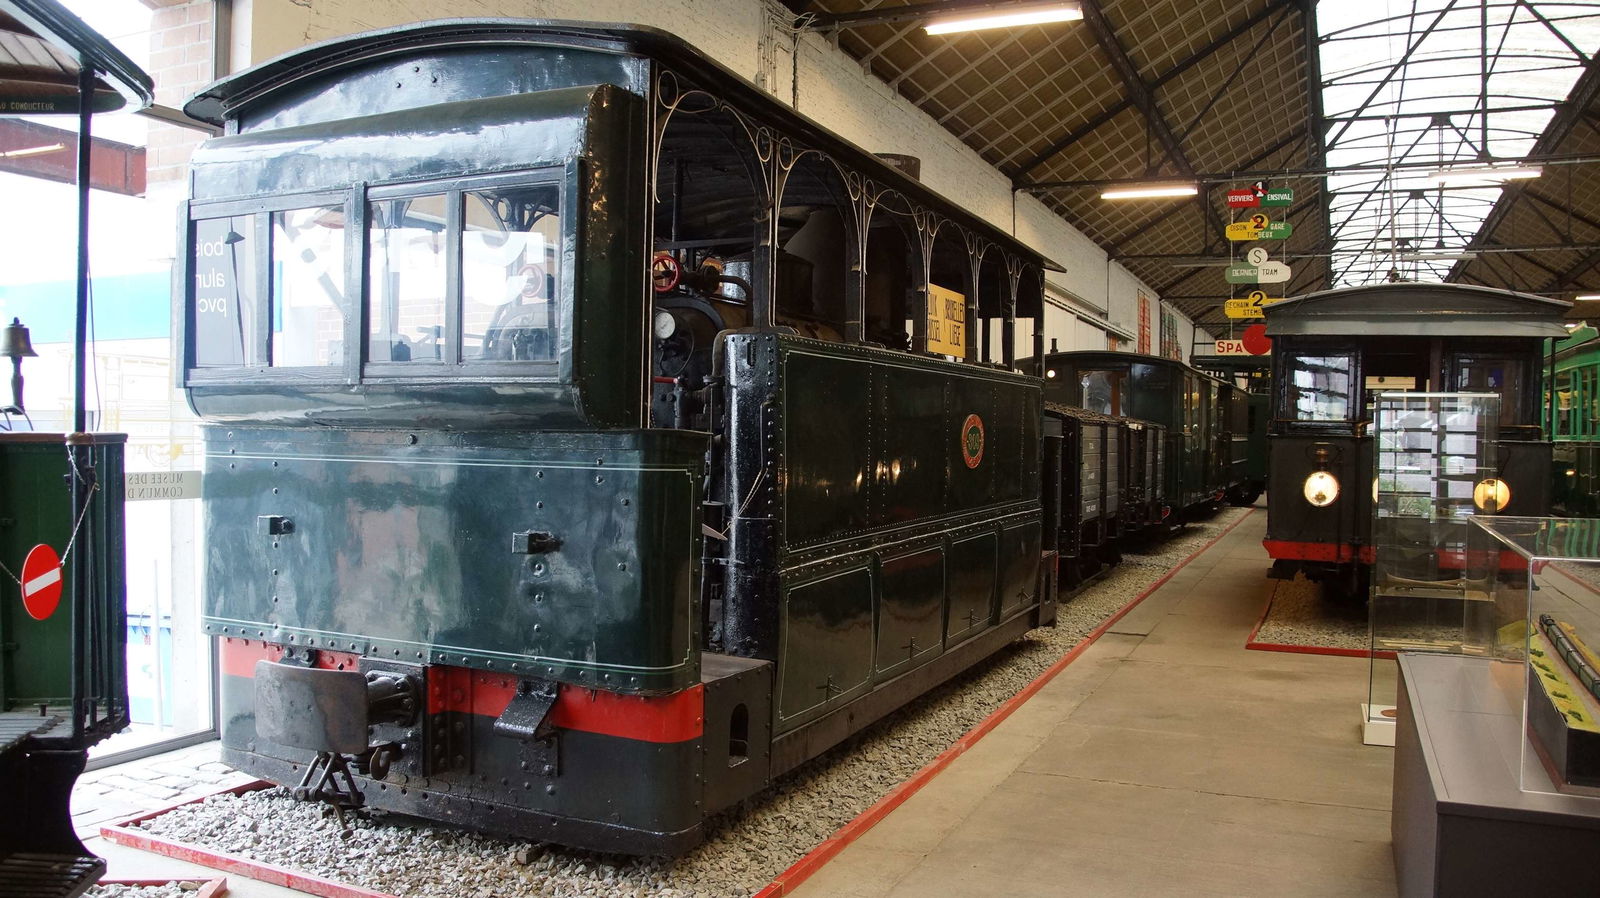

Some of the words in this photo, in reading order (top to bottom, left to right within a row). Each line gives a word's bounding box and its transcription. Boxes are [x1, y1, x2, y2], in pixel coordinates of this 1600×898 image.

[10, 102, 55, 111] CONDUCTEUR
[1228, 194, 1254, 203] VERVIERS
[1267, 193, 1292, 202] ENSIVAL
[1253, 215, 1265, 230] 2
[1253, 250, 1262, 264] S
[1232, 268, 1258, 277] DERNIER
[1252, 292, 1263, 307] 2
[1243, 309, 1263, 317] STEMB
[1217, 341, 1243, 354] SPA
